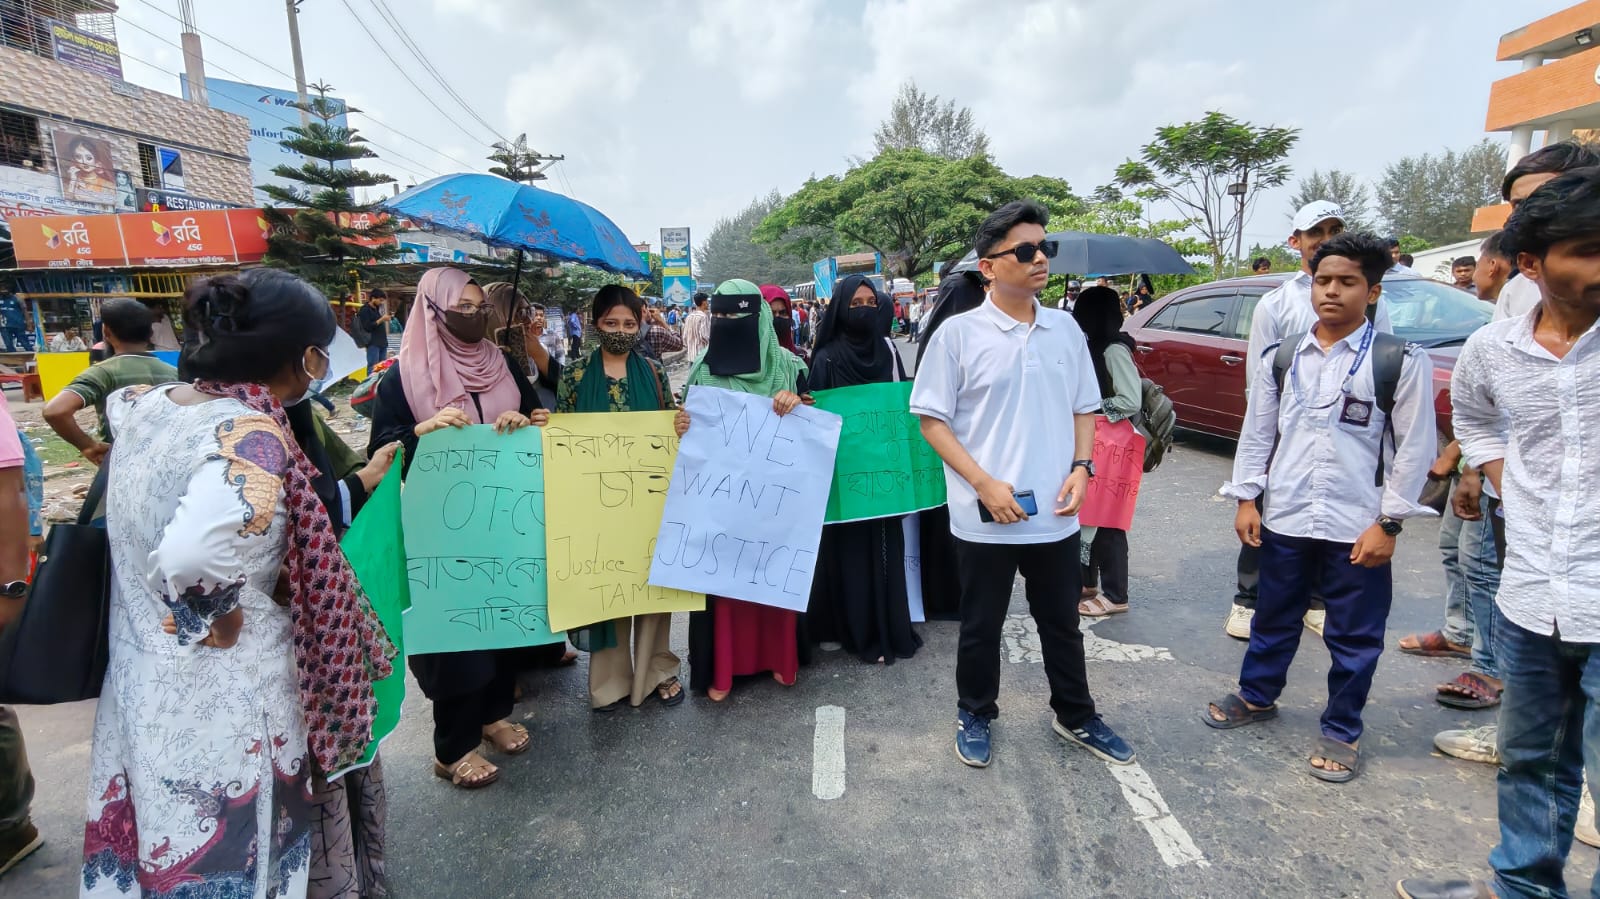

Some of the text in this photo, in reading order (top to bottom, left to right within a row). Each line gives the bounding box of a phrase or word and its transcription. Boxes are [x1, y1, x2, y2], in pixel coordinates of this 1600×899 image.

[61, 221, 90, 248] রবি
[170, 217, 201, 244] রবি
[546, 427, 635, 459] নিরাপদ
[717, 398, 811, 467] WE
[416, 445, 501, 473] আমার
[682, 464, 800, 516] WANT
[552, 533, 637, 581] Justice
[658, 521, 816, 596] JUSTICE
